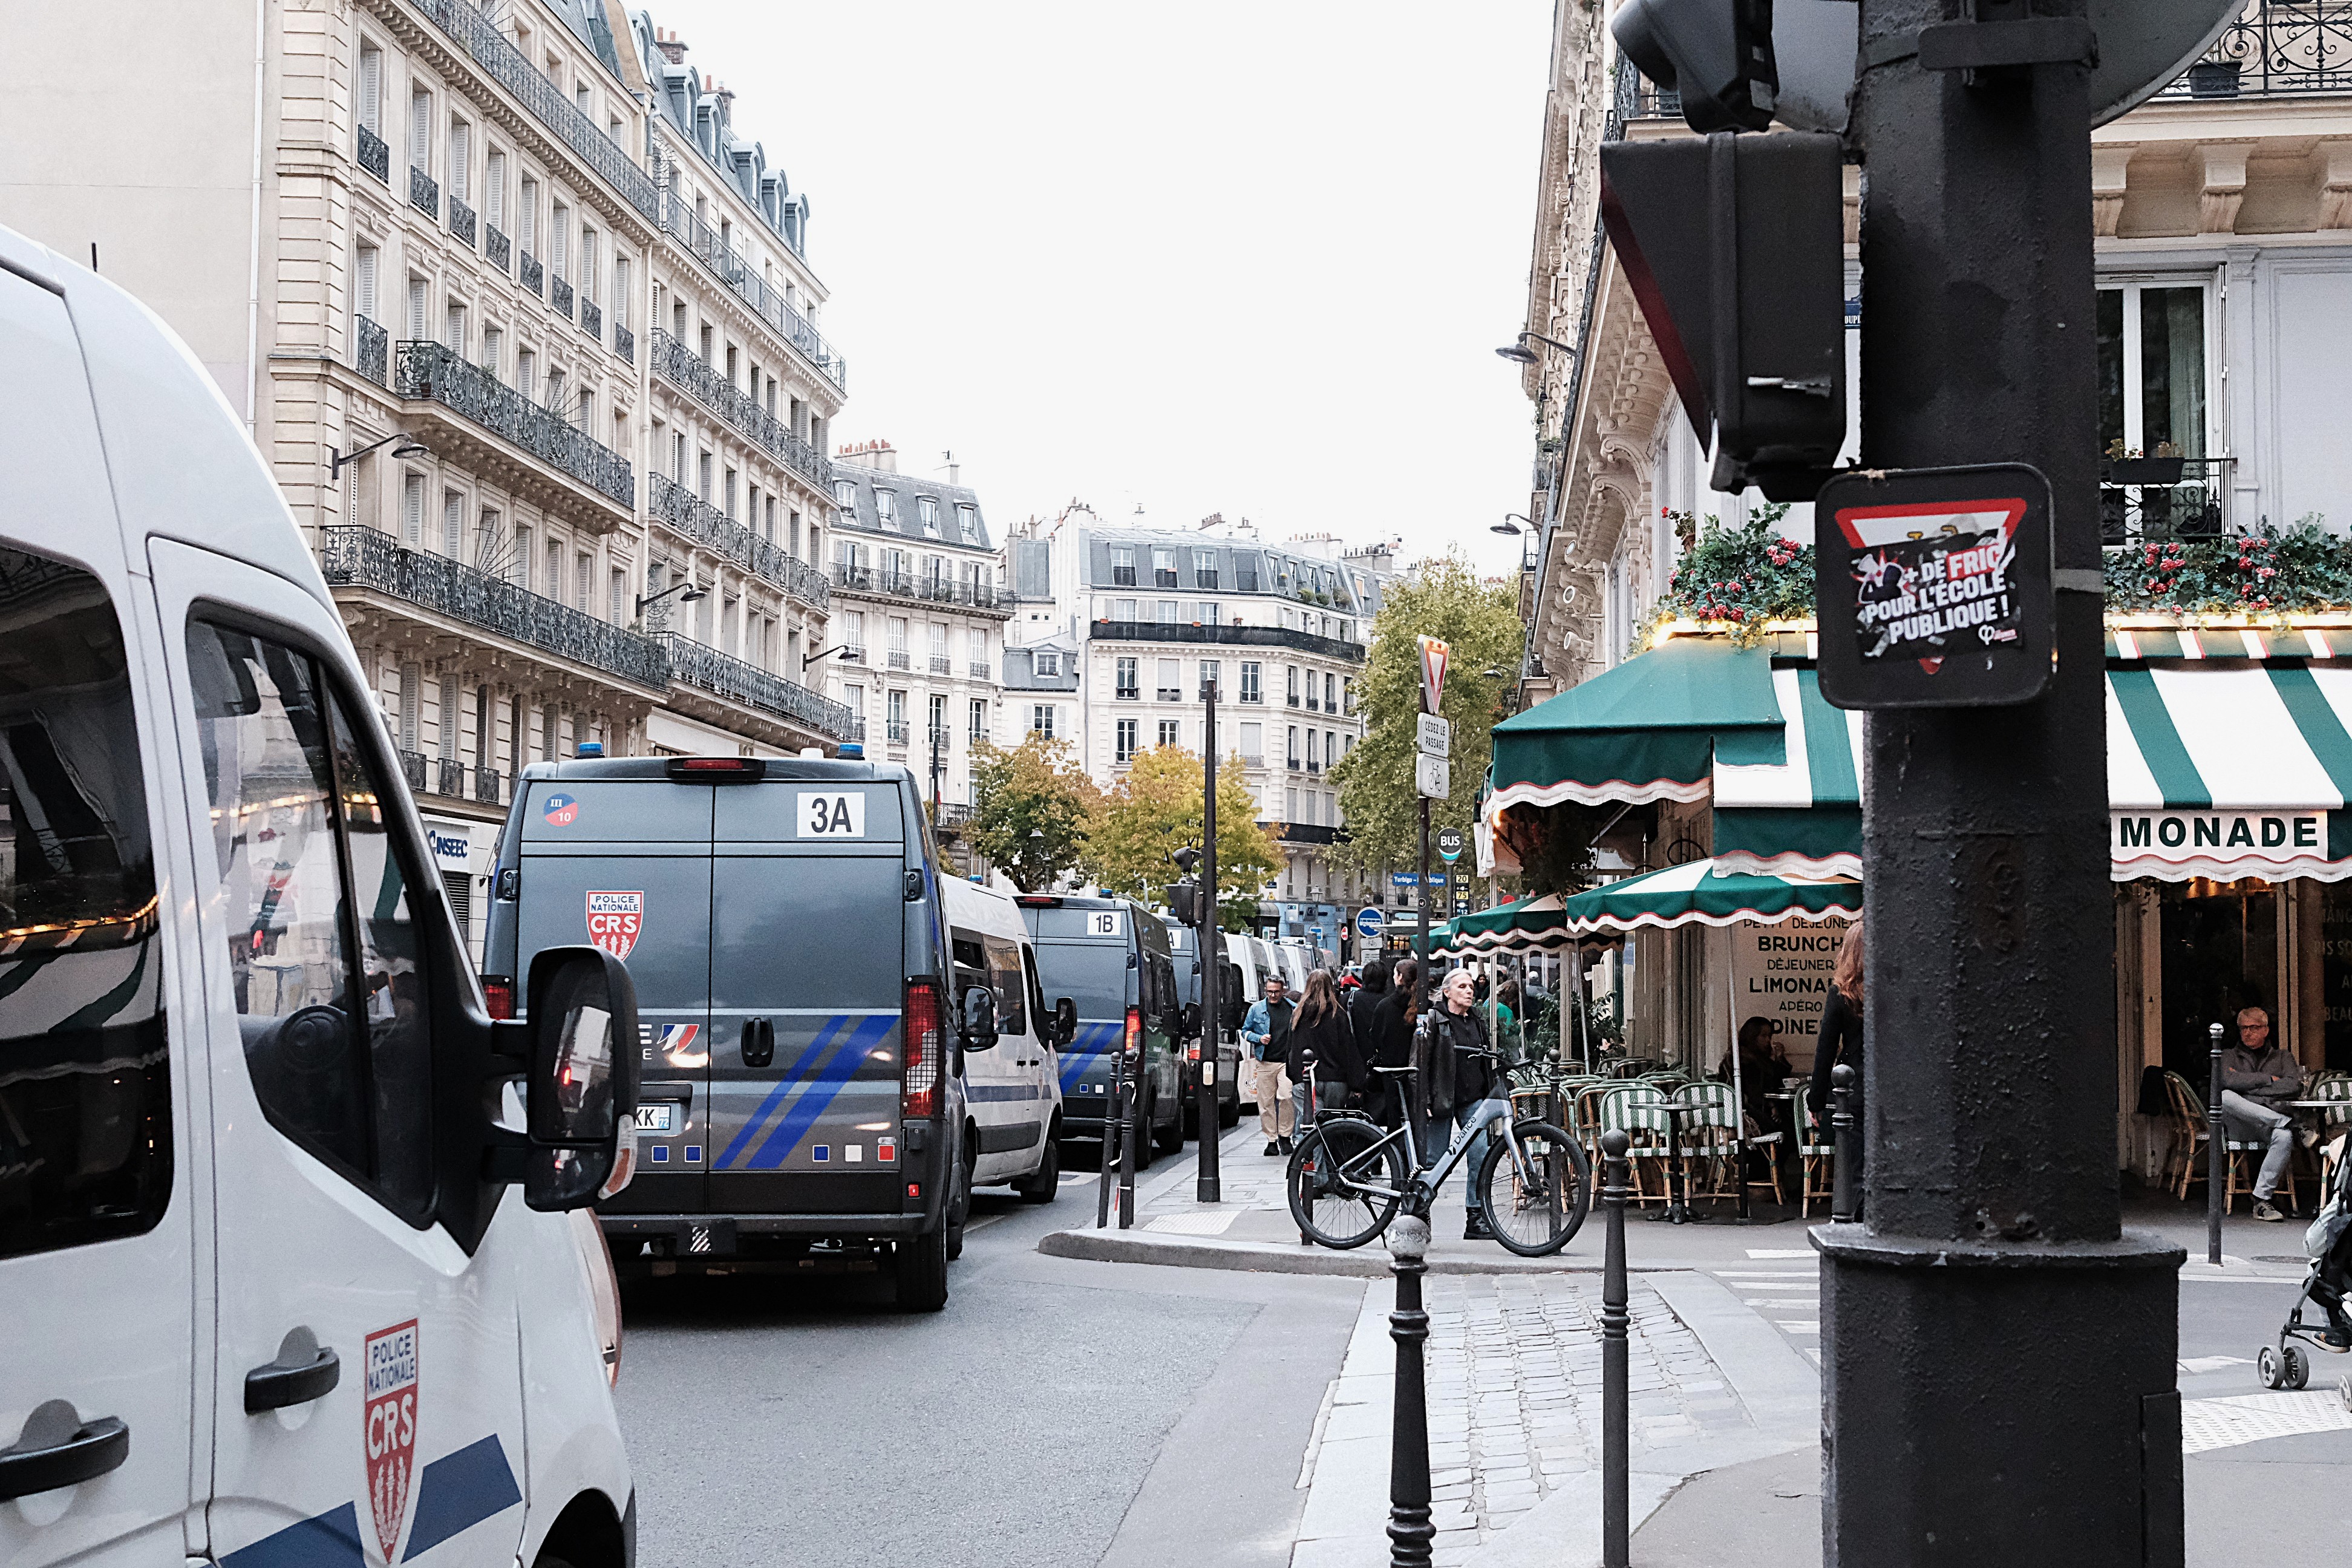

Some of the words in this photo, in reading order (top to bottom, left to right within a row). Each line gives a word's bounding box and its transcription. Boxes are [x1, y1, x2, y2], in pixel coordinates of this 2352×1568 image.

[1921, 558, 1947, 583] DE
[1949, 544, 2001, 578] FRIC
[1865, 595, 1917, 624] POUR
[1919, 569, 2007, 611] L'ÉCOLE
[1888, 597, 1999, 645] PUBLIQUE
[1425, 720, 1439, 734] CÉDEZ
[1440, 725, 1446, 736] LE
[1425, 736, 1445, 751] PASSAGE
[558, 812, 572, 822] 10
[811, 797, 852, 833] 3A
[1440, 835, 1460, 846] BUS
[2120, 817, 2318, 848] MONADE
[590, 915, 637, 934] CRS
[1096, 915, 1114, 933] 1B
[1758, 936, 1844, 952] BRUNCH
[1749, 975, 1833, 994] LIMONA
[1779, 999, 1823, 1012] APÉRO
[1771, 1016, 1822, 1035] DÎNE
[1454, 1116, 1477, 1145] Dance
[372, 1333, 411, 1367] POLICE
[368, 1357, 415, 1395] NATIONALE
[367, 1393, 414, 1461] CRS
